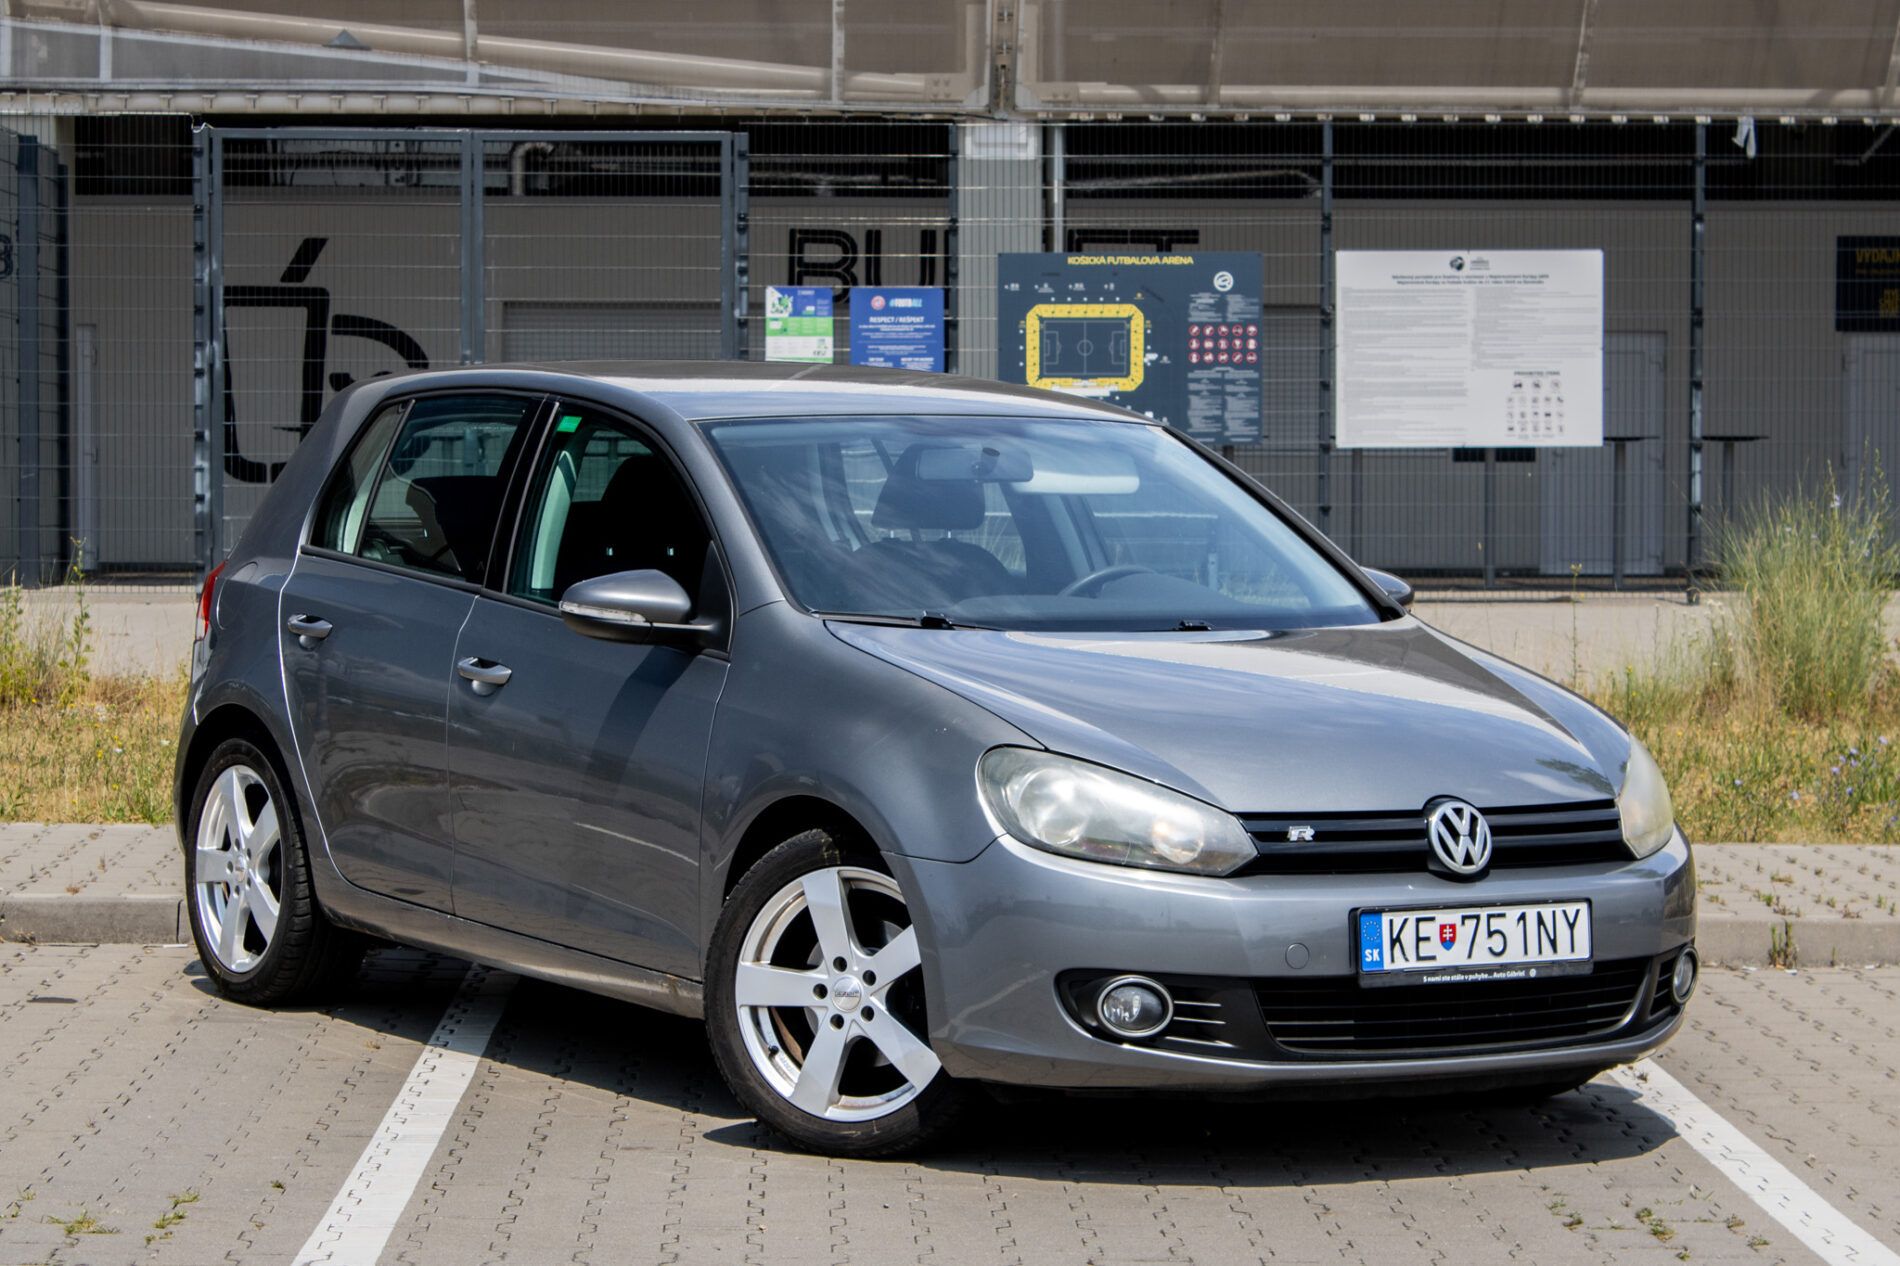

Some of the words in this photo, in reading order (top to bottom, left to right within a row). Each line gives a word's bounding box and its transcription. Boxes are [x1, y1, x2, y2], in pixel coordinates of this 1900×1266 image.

[1389, 915, 1437, 963] KE
[1460, 908, 1581, 960] 751NY
[1364, 948, 1380, 962] SK
